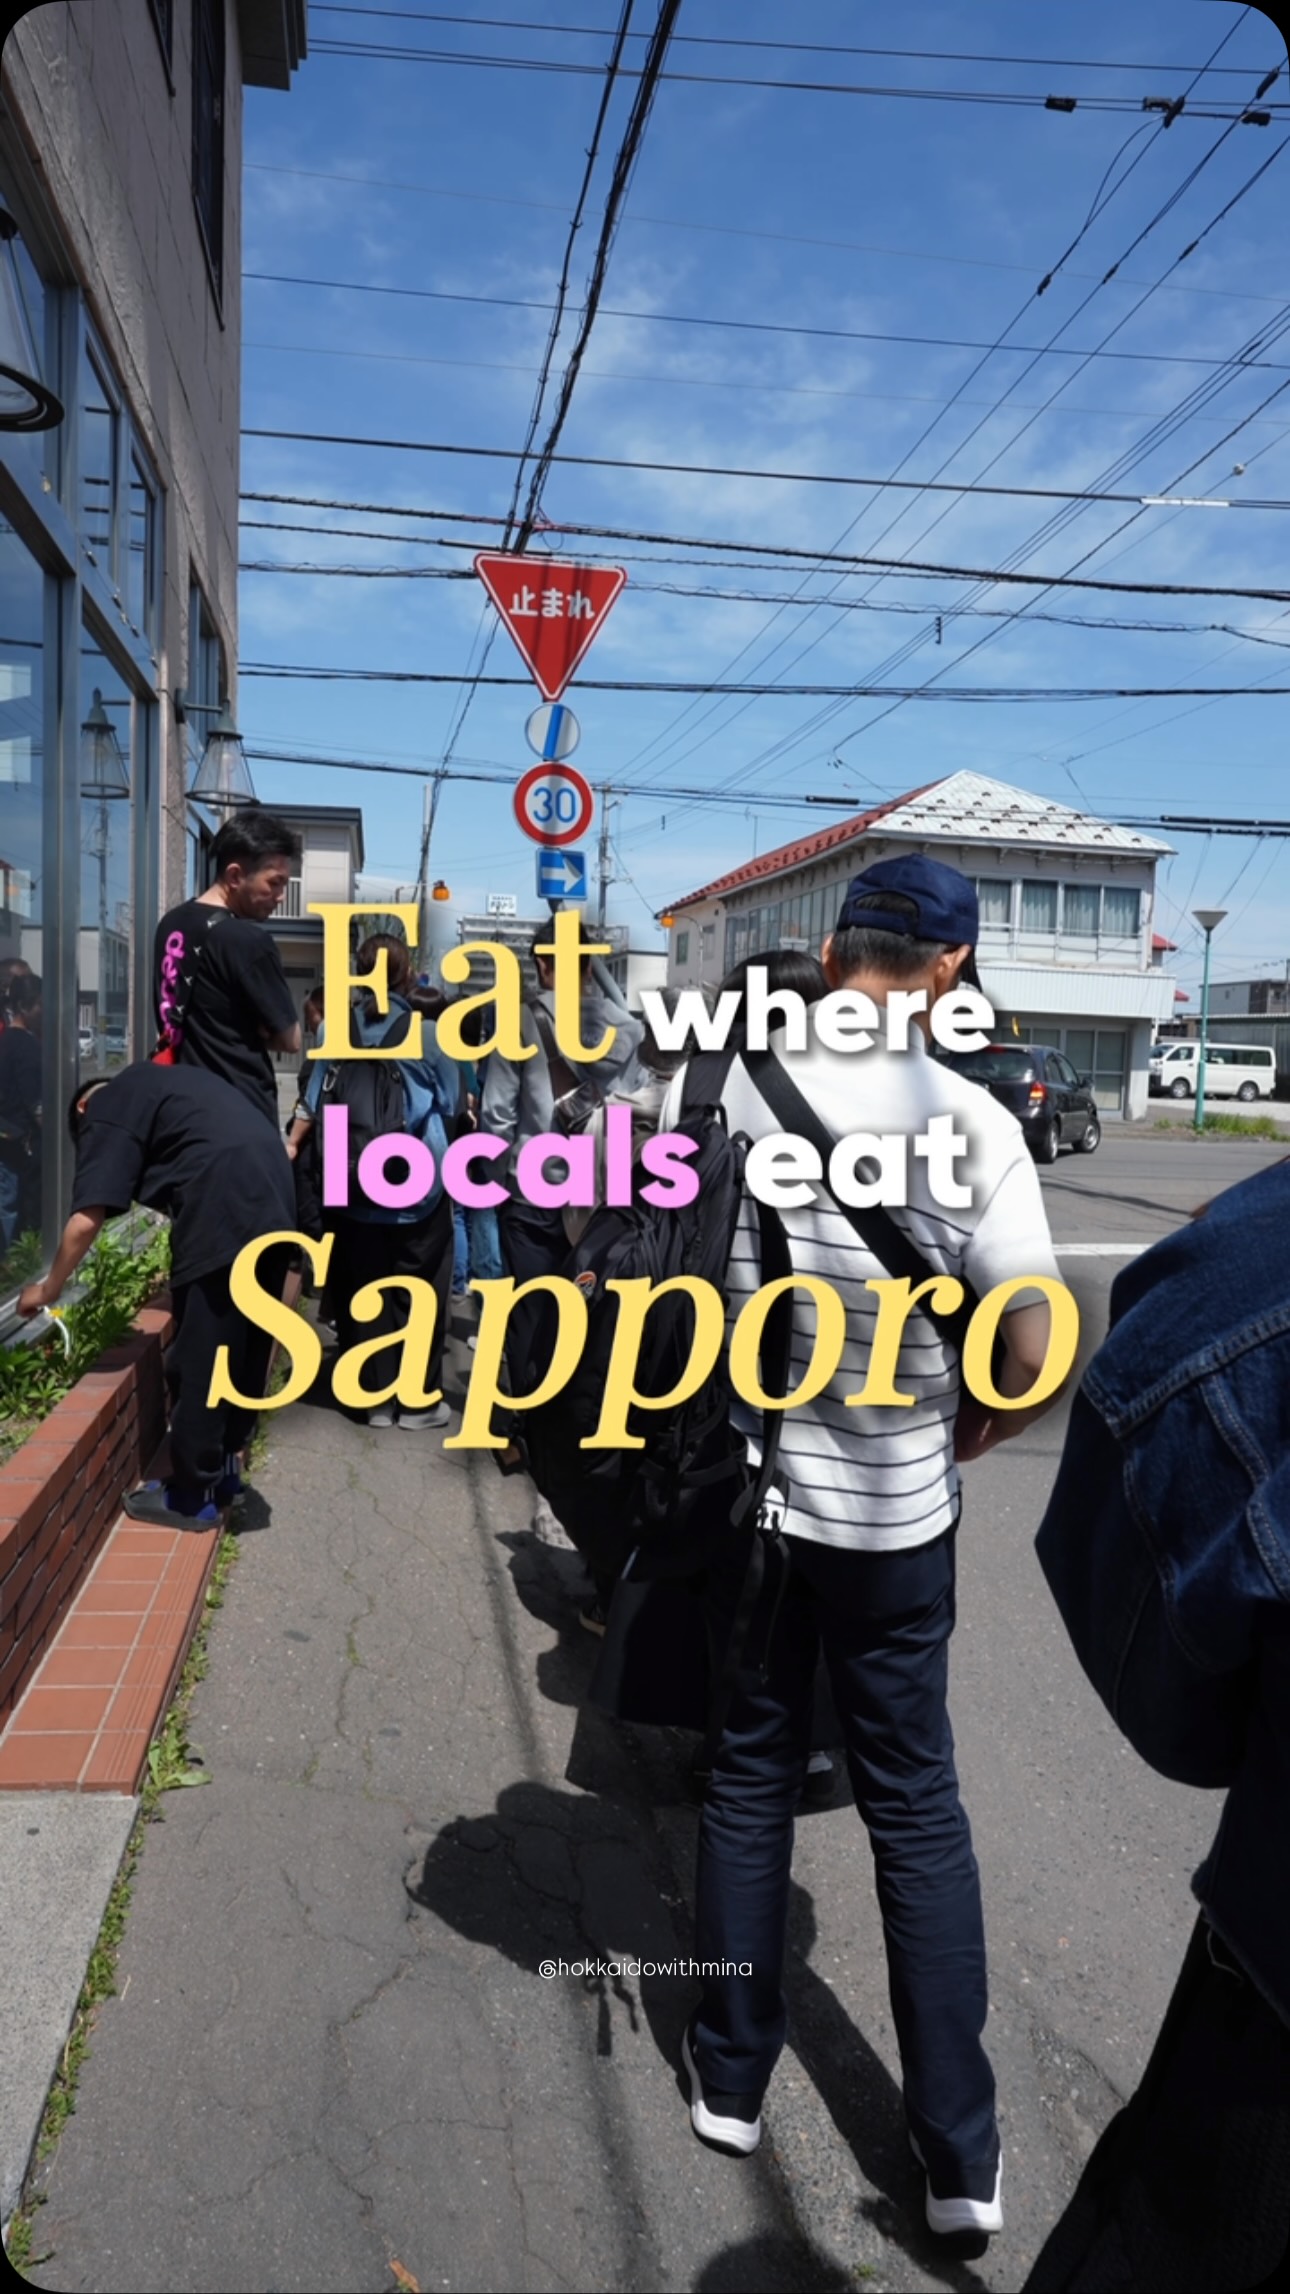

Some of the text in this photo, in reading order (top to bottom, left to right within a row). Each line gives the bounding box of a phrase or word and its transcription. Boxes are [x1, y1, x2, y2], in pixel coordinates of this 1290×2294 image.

[508, 585, 595, 619] 止まれ
[533, 786, 576, 823] 30
